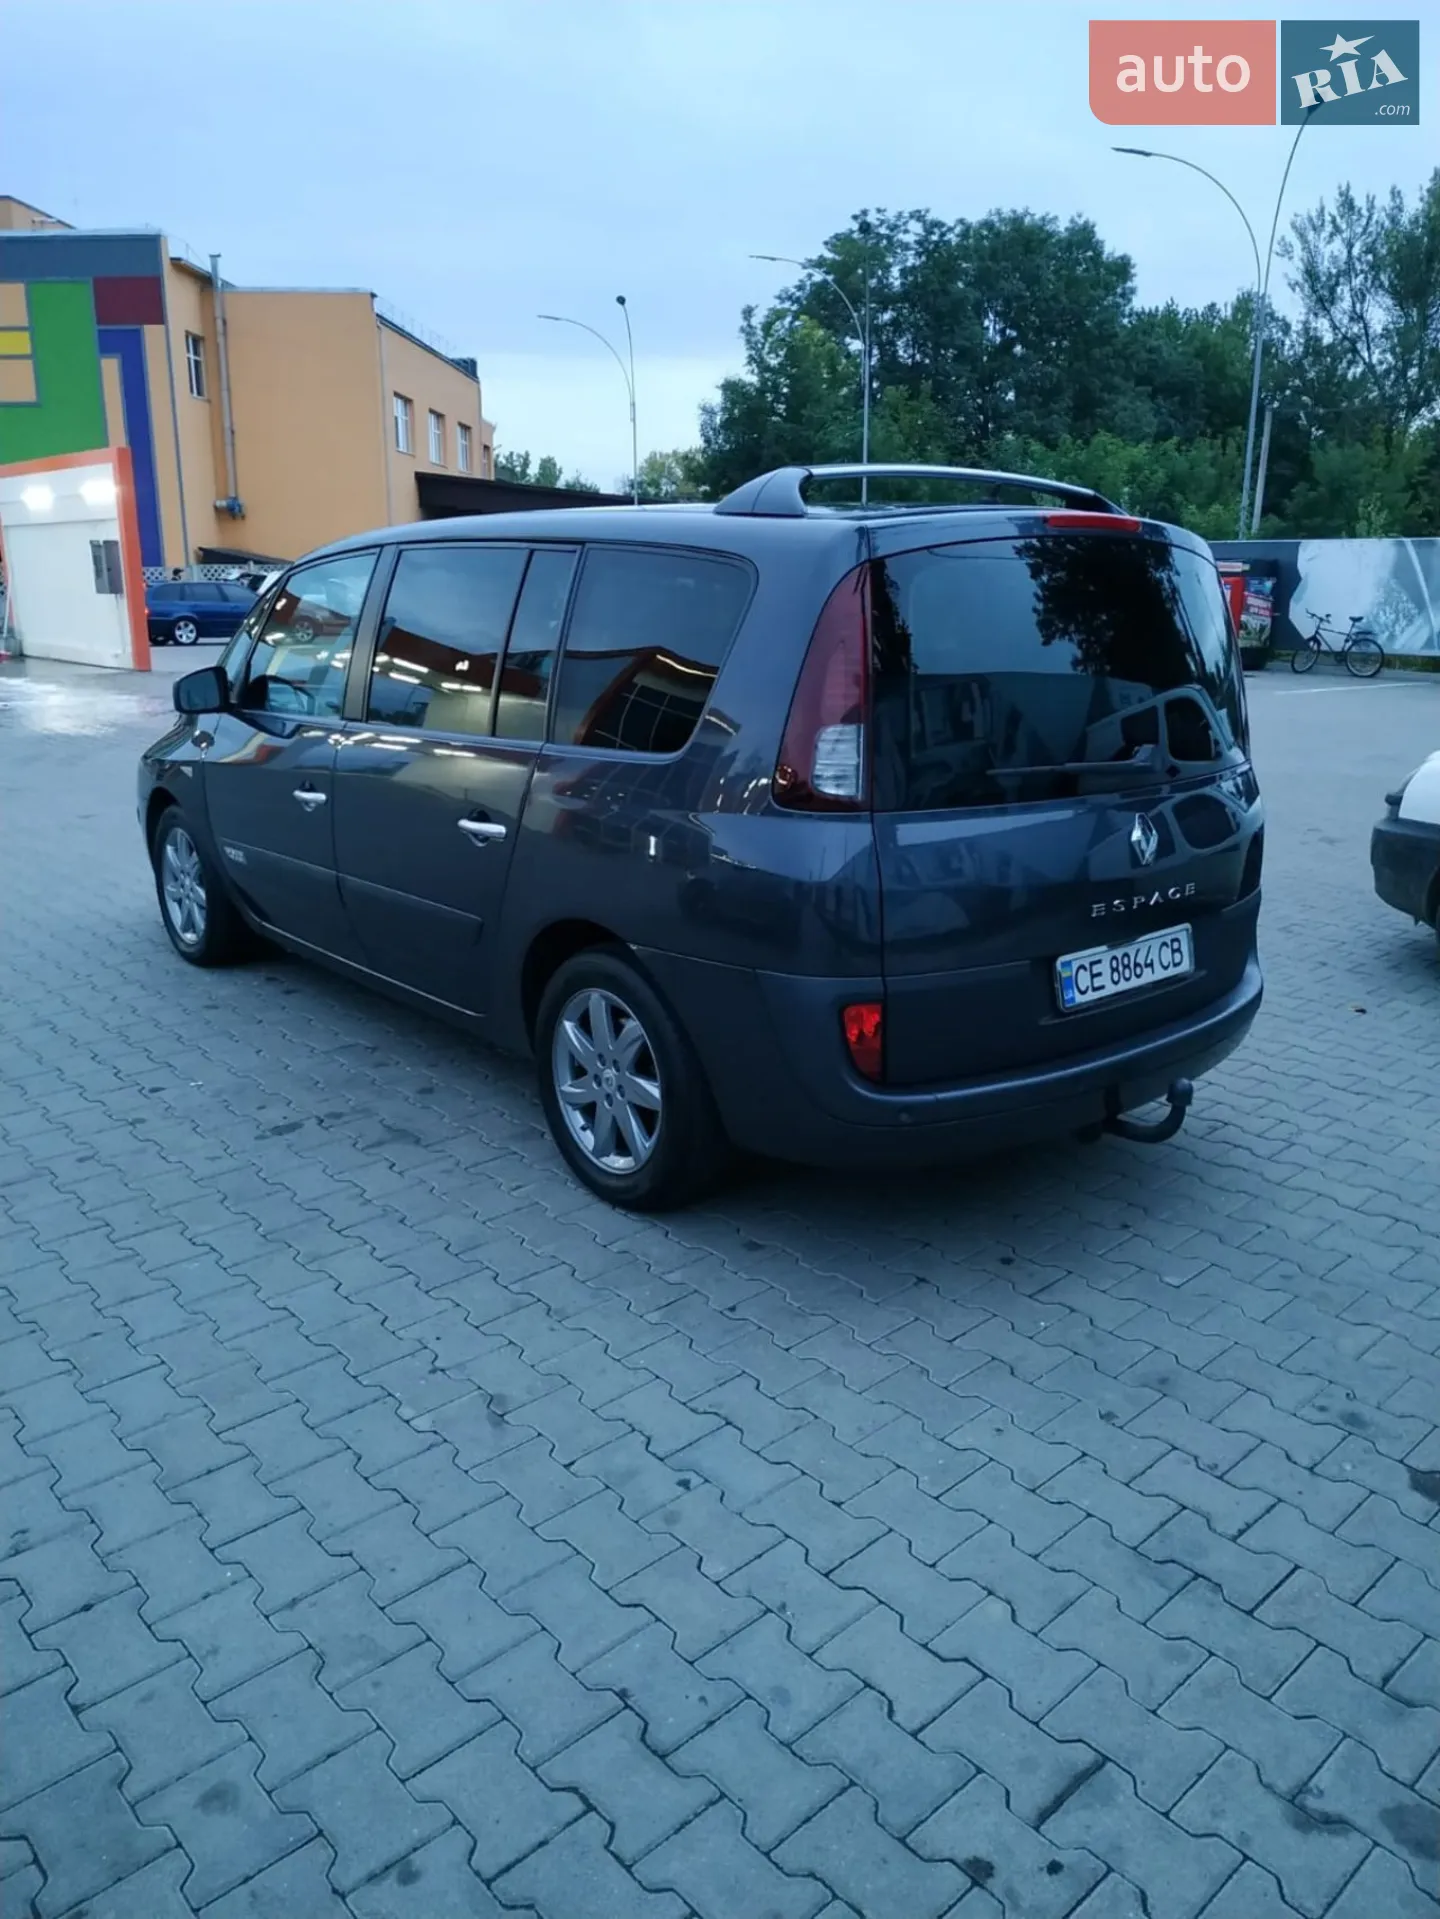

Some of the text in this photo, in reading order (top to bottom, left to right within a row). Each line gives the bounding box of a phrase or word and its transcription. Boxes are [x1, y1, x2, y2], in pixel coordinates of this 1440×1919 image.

[1091, 882, 1196, 917] ESPACE
[1074, 937, 1184, 995] CE 8864 CB
